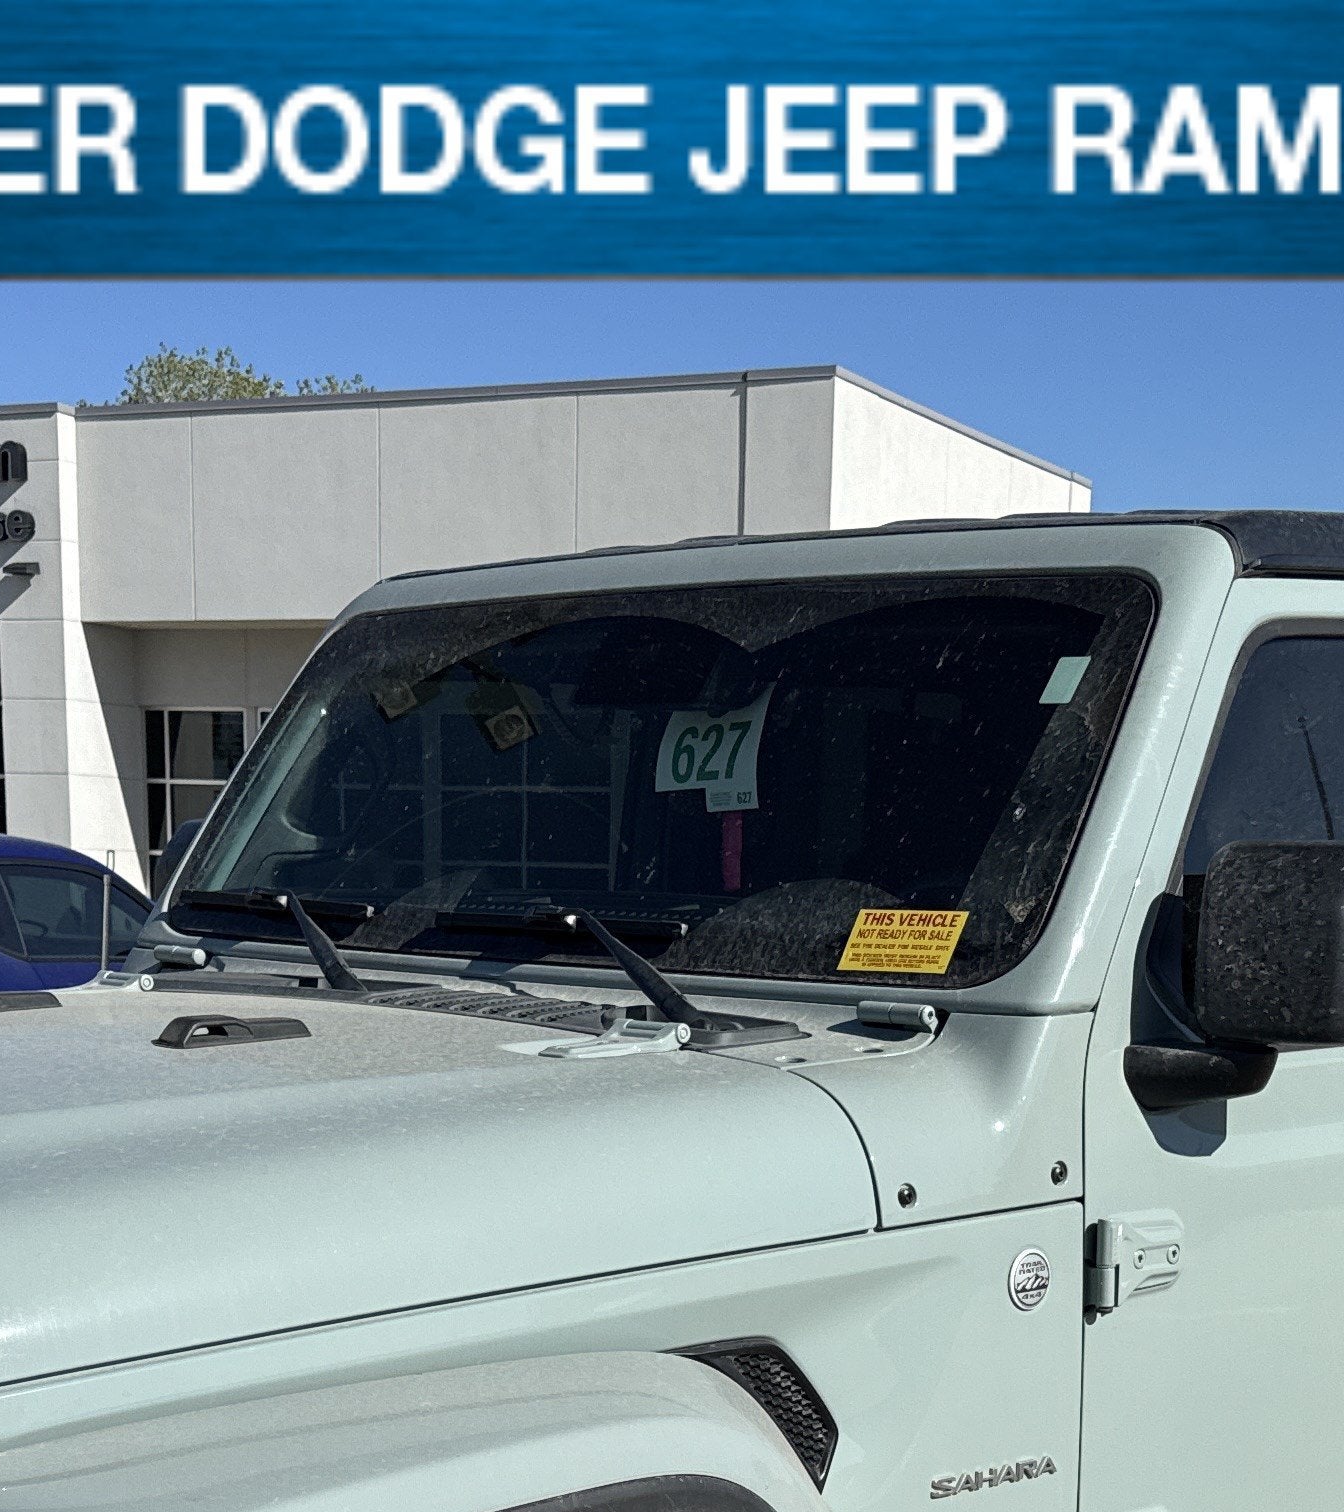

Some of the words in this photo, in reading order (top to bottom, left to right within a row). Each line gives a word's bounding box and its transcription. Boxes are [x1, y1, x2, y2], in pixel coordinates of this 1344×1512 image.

[671, 719, 753, 784] 627
[736, 791, 753, 804] 627
[862, 912, 896, 927] THIS
[898, 912, 962, 928] VEHICLE
[855, 928, 877, 940] NOT
[876, 928, 909, 940] READY
[907, 929, 928, 941] FOR
[927, 930, 954, 942] SALE
[929, 1455, 1058, 1500] SAHARA
